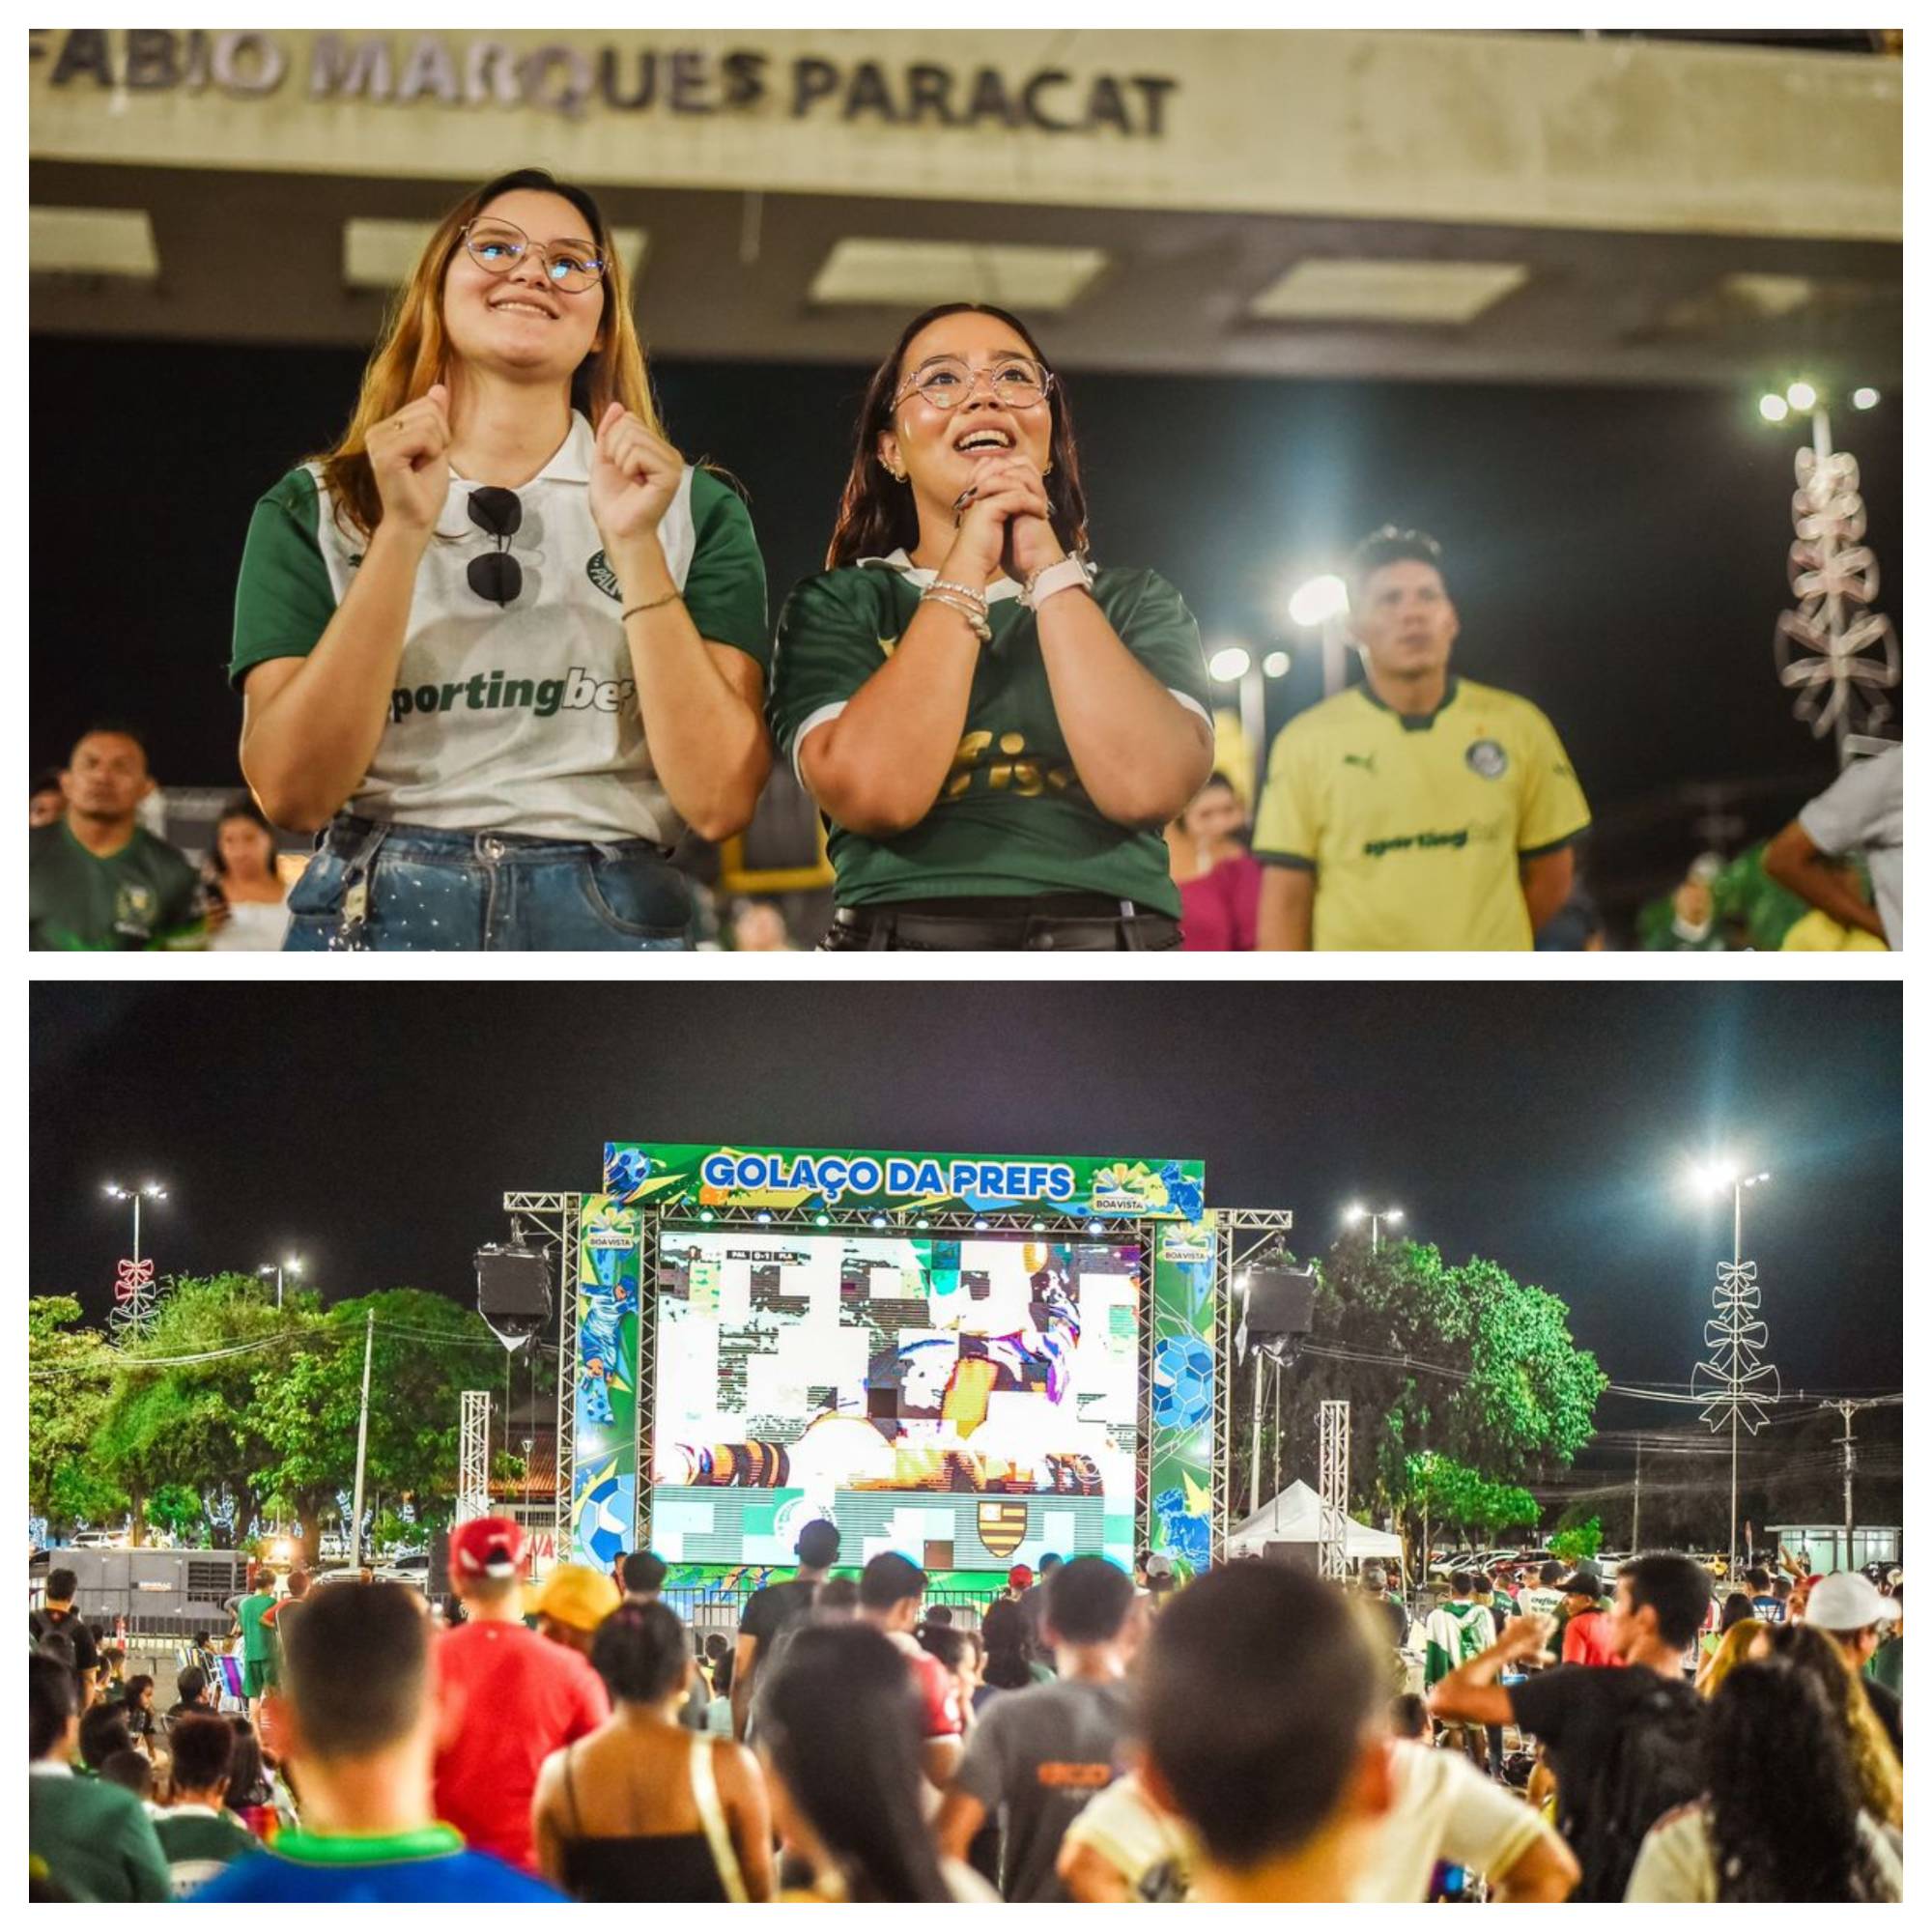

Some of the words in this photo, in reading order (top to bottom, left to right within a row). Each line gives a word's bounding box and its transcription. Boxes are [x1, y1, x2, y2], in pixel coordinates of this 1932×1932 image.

[309, 32, 769, 118] MARQUES
[787, 55, 1179, 137] PARACAT
[388, 667, 637, 723] portingbe
[704, 1155, 880, 1199] GOLAÇO
[890, 1162, 942, 1193] DA
[952, 1164, 1073, 1198] PREFS
